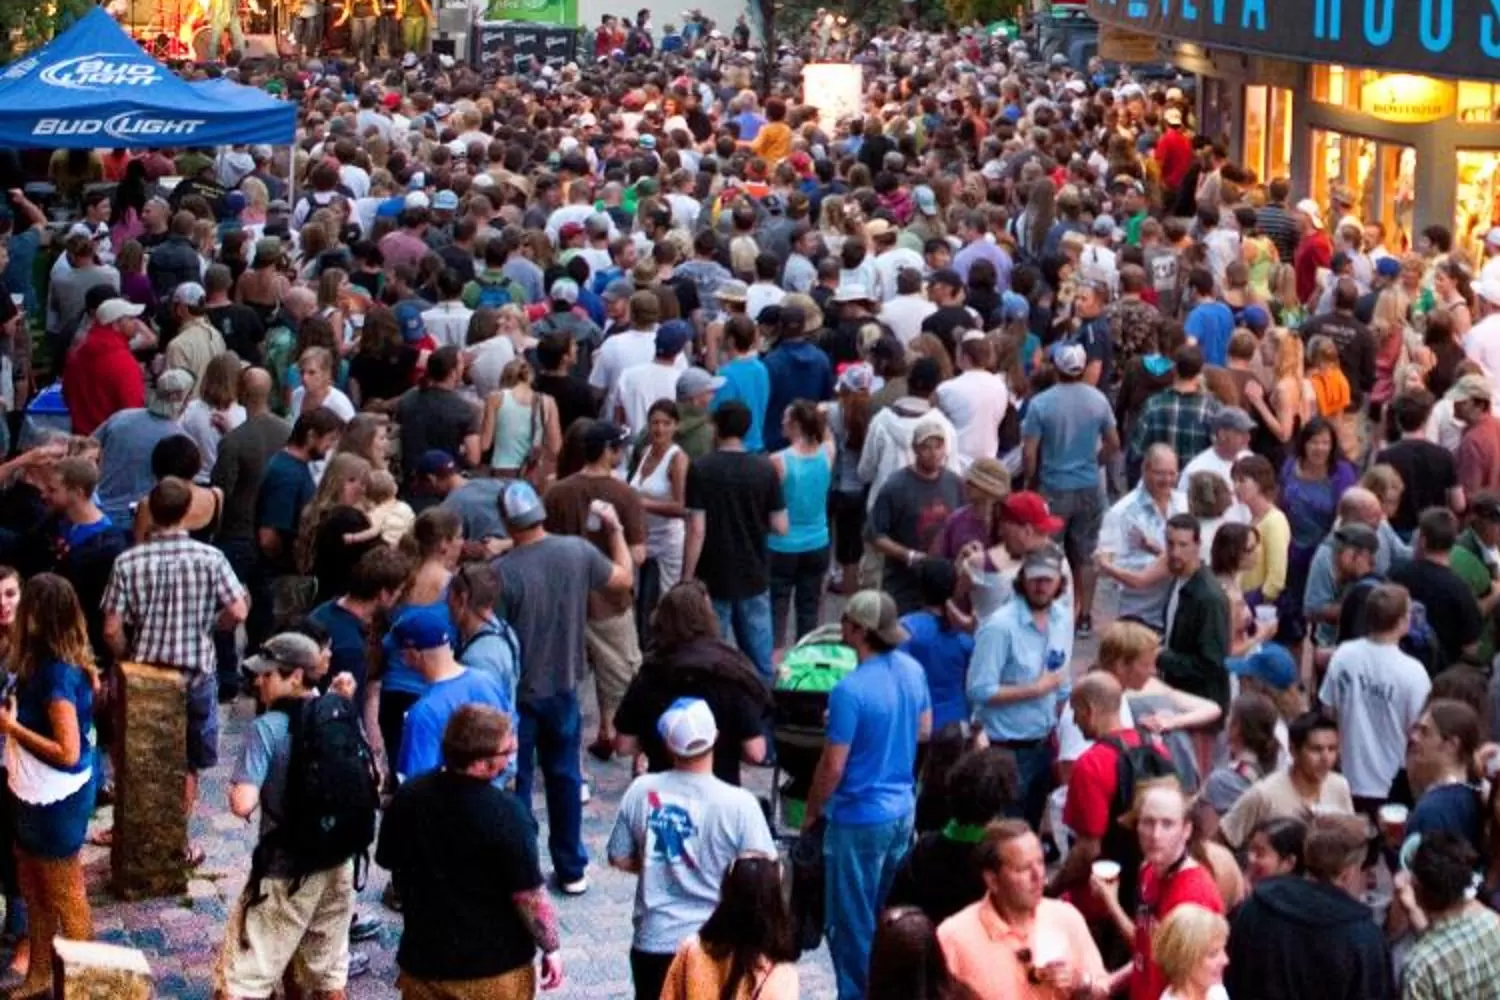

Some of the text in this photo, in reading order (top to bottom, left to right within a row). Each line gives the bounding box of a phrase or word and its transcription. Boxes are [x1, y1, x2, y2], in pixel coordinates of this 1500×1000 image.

[75, 59, 156, 75] BUD
[32, 118, 206, 135] BUD LIGHT
